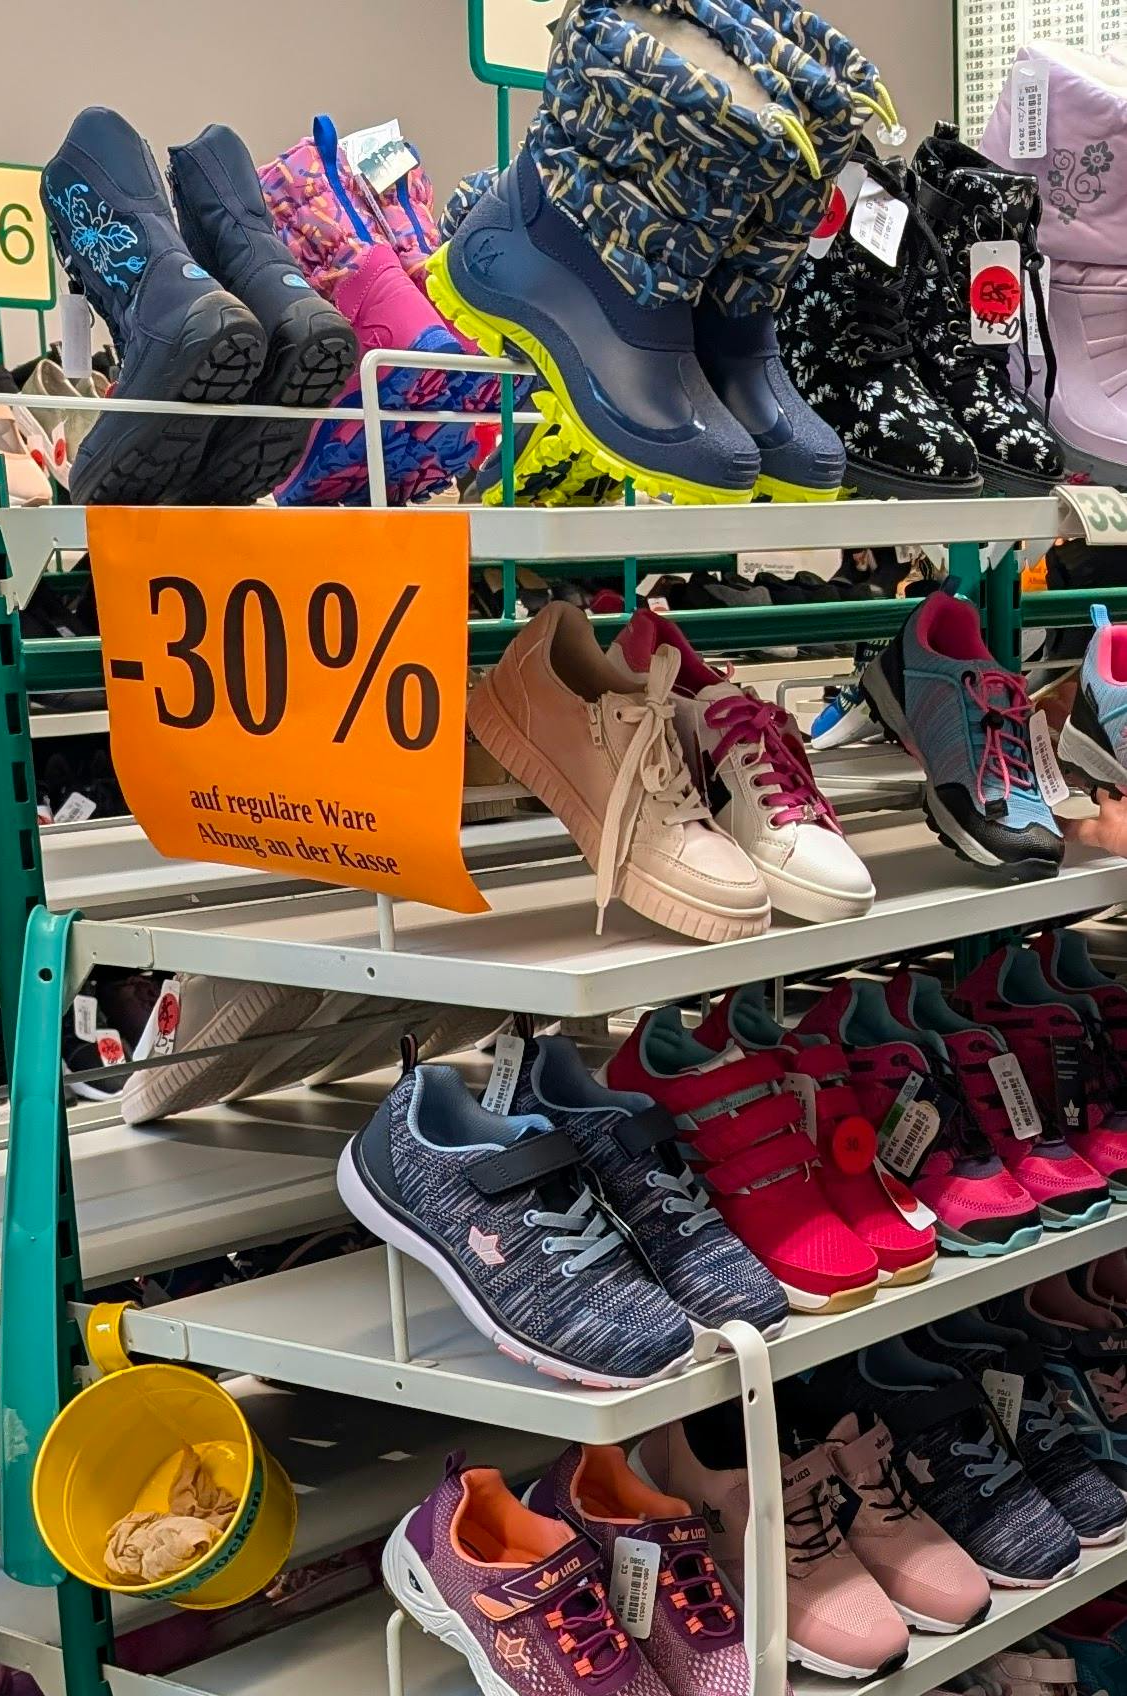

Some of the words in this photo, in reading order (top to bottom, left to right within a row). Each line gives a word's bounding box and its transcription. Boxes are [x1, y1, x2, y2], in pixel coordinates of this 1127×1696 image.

[189, 786, 221, 813] auf
[227, 792, 313, 824] reguläre
[315, 799, 378, 833] Ware
[197, 823, 266, 858] Abzug
[267, 837, 293, 858] an
[296, 837, 332, 865] der
[335, 843, 401, 876] Kasse
